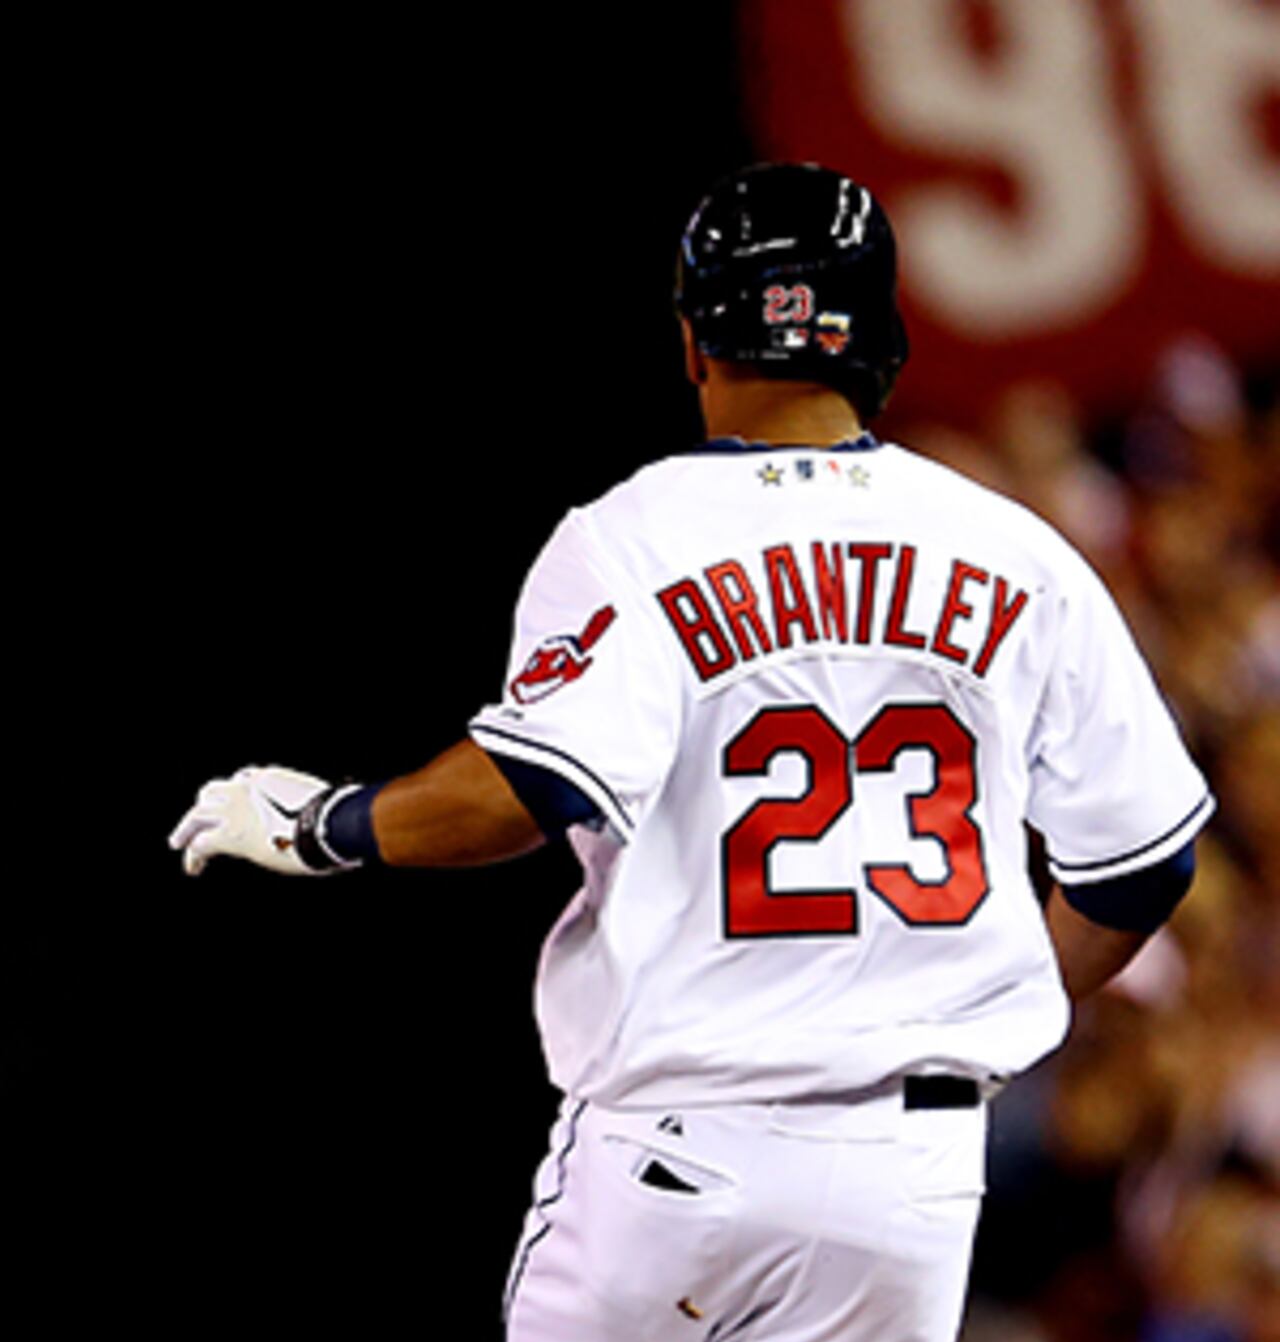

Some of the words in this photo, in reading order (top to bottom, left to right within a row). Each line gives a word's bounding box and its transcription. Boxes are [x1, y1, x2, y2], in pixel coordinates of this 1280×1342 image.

[763, 284, 814, 324] 23
[657, 542, 1028, 682] BRANTLEY
[722, 704, 990, 939] 23
